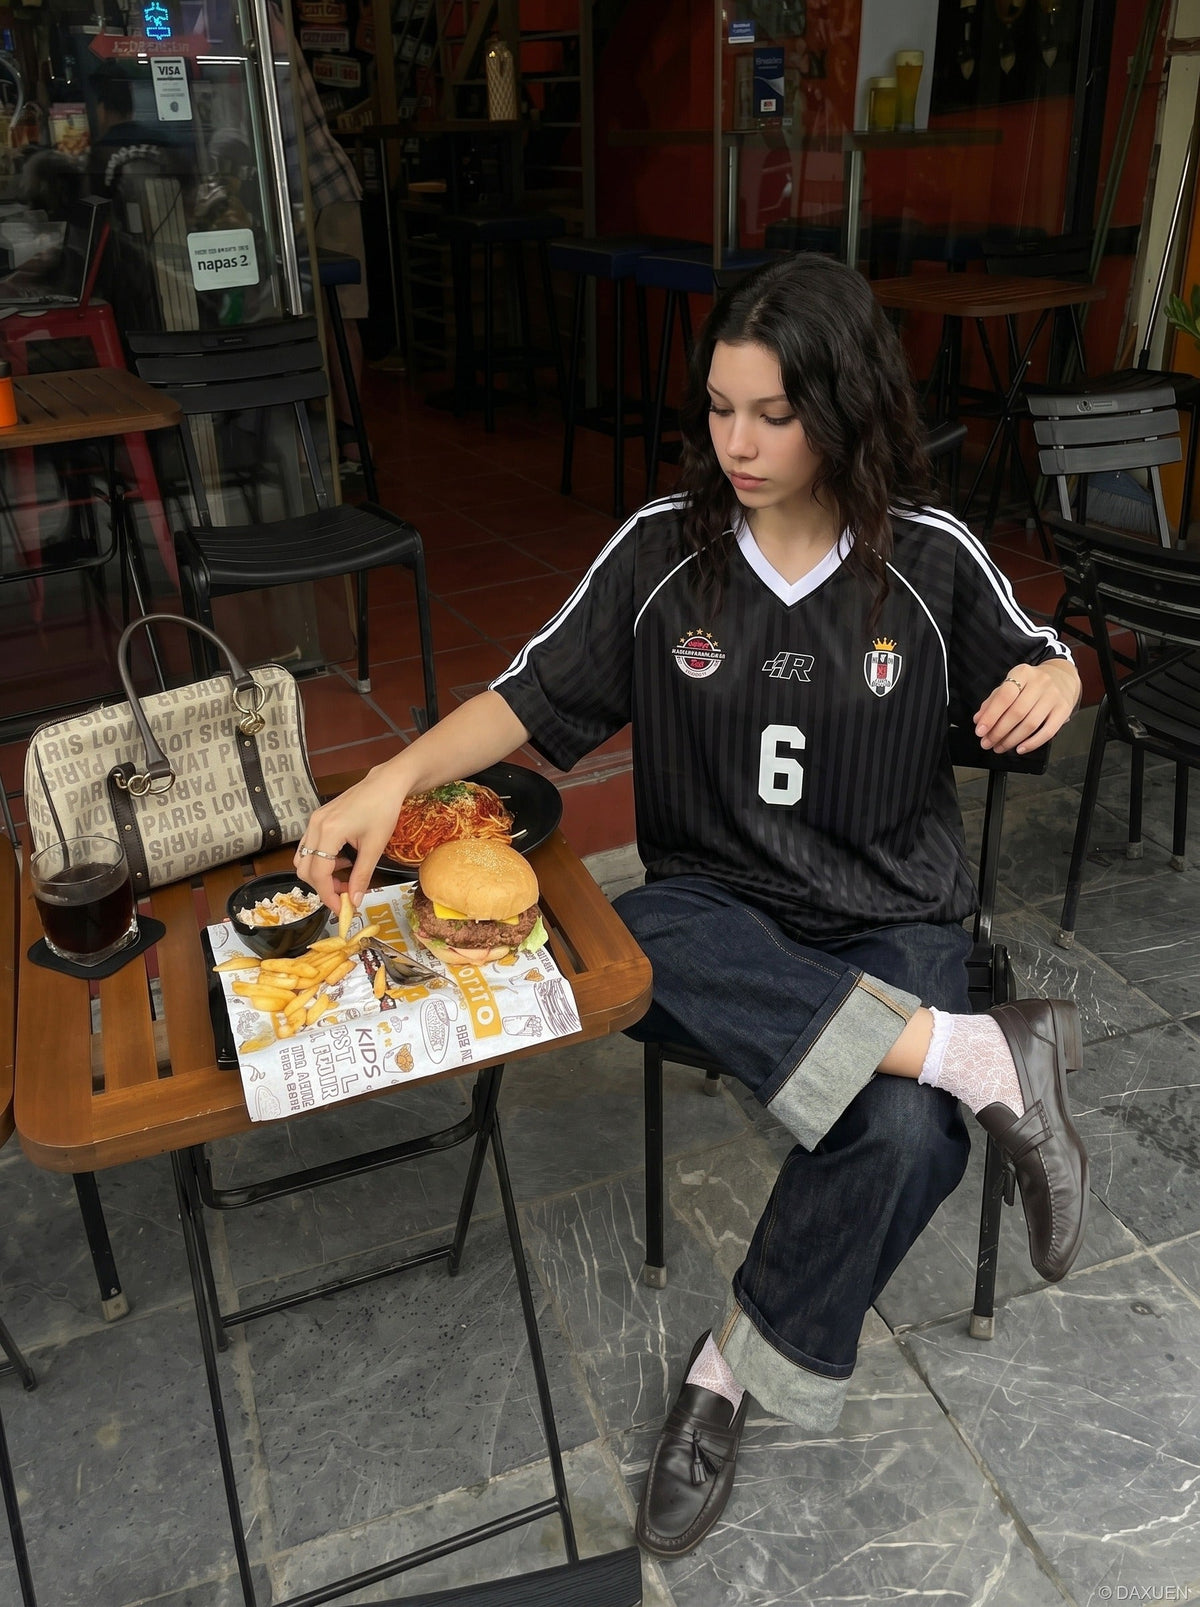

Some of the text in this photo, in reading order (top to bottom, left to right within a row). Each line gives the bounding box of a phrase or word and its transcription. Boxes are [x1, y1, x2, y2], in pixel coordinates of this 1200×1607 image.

[157, 66, 181, 76] VISA
[198, 257, 238, 273] napas
[758, 724, 806, 806] 6
[142, 800, 207, 837] PARIS
[184, 837, 245, 872] PARIS
[355, 1027, 382, 1079] KIDS
